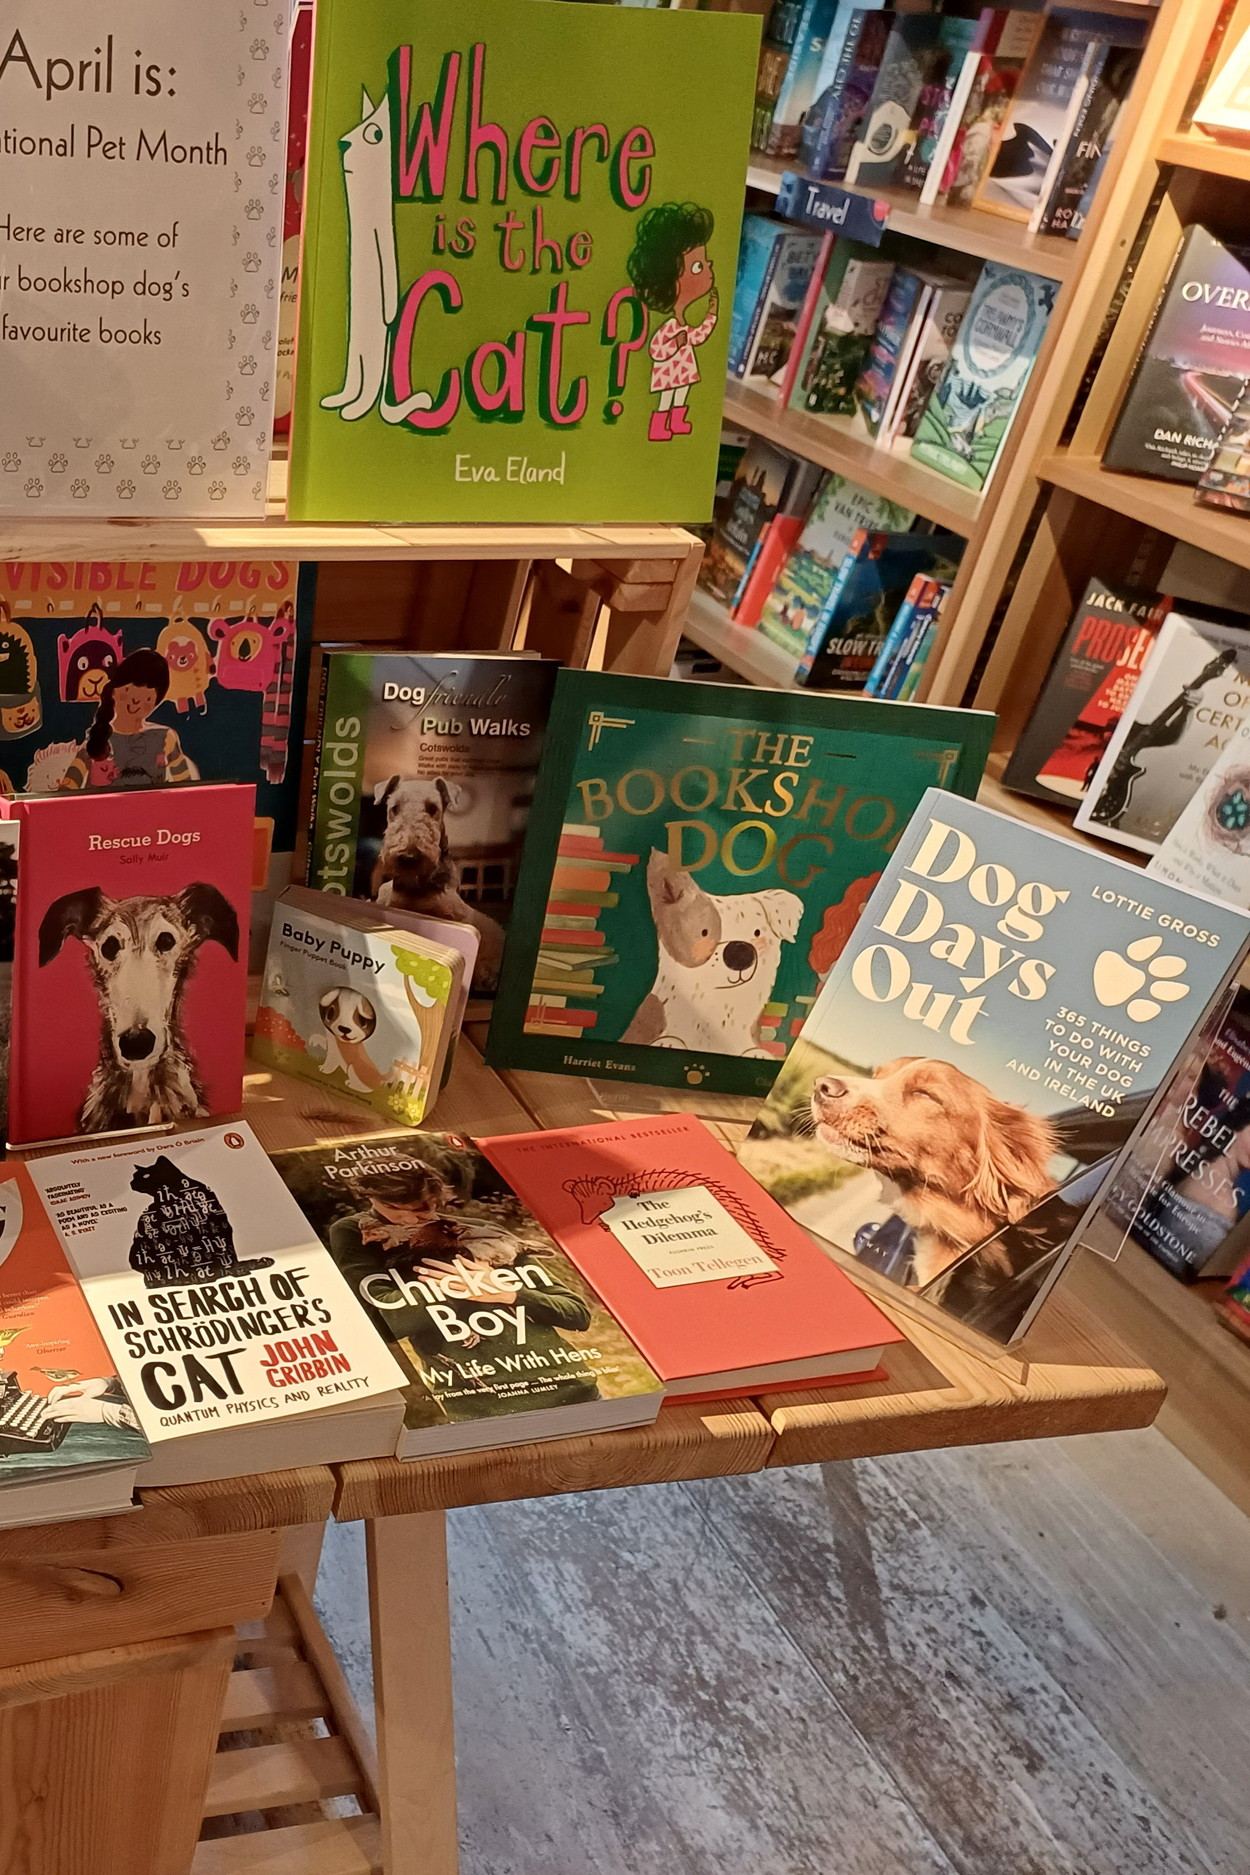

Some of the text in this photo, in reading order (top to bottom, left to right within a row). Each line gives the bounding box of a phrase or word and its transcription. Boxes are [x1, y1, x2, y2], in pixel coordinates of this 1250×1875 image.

[134, 49, 177, 97] is:
[86, 126, 125, 160] Pet
[136, 128, 228, 166] Month
[388, 43, 655, 210] Where
[806, 186, 850, 225] Travel
[54, 224, 85, 244] are
[94, 227, 149, 246] some
[157, 222, 179, 248] of
[434, 206, 592, 271] is the
[17, 265, 125, 297] bookshop
[133, 270, 190, 302] dog's
[1182, 281, 1250, 311] OVER
[2, 315, 162, 346] favourite books
[393, 270, 648, 429] Cat?
[1153, 428, 1219, 449] DAN RICH
[455, 452, 565, 484] Eva Eland
[175, 560, 291, 592] DOGS
[1086, 592, 1123, 612] JACK
[826, 637, 869, 656] SLOW
[384, 682, 425, 705] Dog
[422, 716, 530, 736] Pub Walks
[420, 742, 470, 753] Cotswolds
[726, 728, 815, 768] THE
[318, 716, 361, 897] otswolds
[576, 766, 914, 854] BOOKSHO
[88, 829, 201, 851] Rescue Dogs
[119, 852, 169, 866] Sally Muir
[664, 819, 835, 889] DOG
[903, 818, 1071, 943] Dog
[1090, 885, 1221, 949] LOTTIE GROSS
[279, 941, 347, 971] Finger Puppet Book
[282, 922, 386, 975] Baby Puppy
[872, 878, 1057, 1001] Days
[851, 943, 991, 1046] Out
[1044, 1019, 1144, 1074] TO DO WITH
[1056, 1006, 1087, 1029] 365
[1090, 1020, 1152, 1058] THINGS
[563, 1055, 636, 1073] Harriet Evans
[1043, 1057, 1127, 1104] IN THE UK
[1048, 1039, 1134, 1088] YOUR DOG
[1005, 1058, 1116, 1118] AND IRELAND
[1177, 1092, 1238, 1159] REBEL
[324, 1156, 426, 1181] Parkinson
[333, 1143, 400, 1164] Arthur
[621, 1209, 713, 1232] Hedgehog's
[637, 1199, 670, 1213] The
[641, 1226, 719, 1246] Dilemma
[358, 1259, 554, 1310] Chicken
[647, 1254, 764, 1280] Toon Tellegen
[108, 1266, 311, 1331] IN SEARCH OF
[124, 1298, 332, 1359] SCHRÖDINGER'S
[425, 1304, 528, 1346] Boy
[259, 1330, 339, 1368] JOHN
[418, 1344, 602, 1387] My Life With Hens
[140, 1347, 248, 1411] CAT
[266, 1352, 352, 1388] GRIBBIN
[159, 1375, 370, 1427] QUANTUM PHYSICS AND REALITY
[498, 1384, 559, 1399] JOANNA LUMLEY
